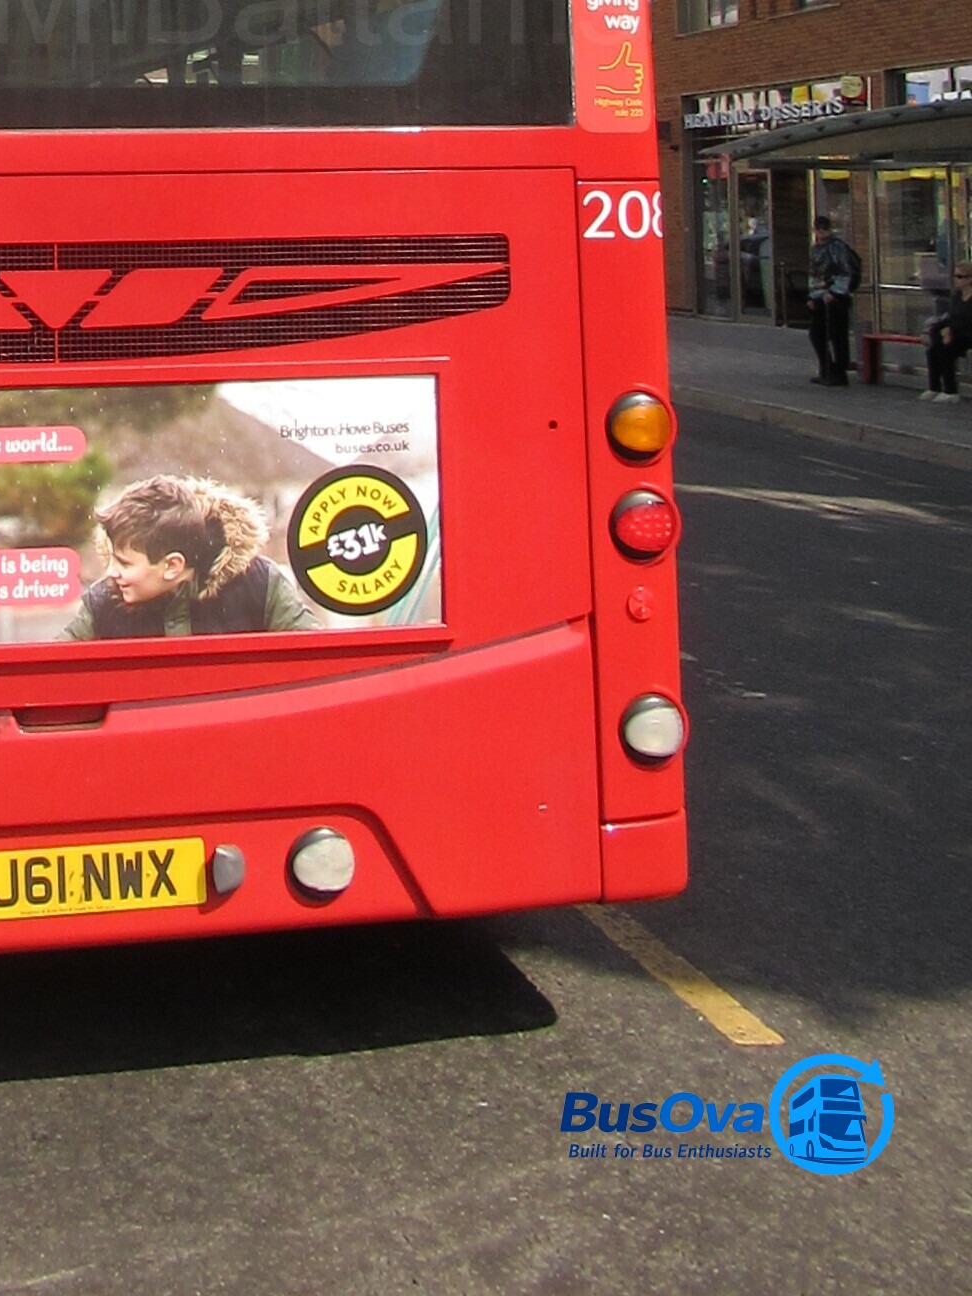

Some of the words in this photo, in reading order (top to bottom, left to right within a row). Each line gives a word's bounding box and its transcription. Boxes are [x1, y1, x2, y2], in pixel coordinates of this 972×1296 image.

[604, 14, 640, 34] way
[684, 110, 755, 130] HEAVENLY
[760, 96, 845, 121] DESSERTS
[373, 422, 409, 434] Buses
[5, 432, 74, 453] world...
[335, 440, 410, 454] buses.co.uk
[308, 488, 346, 535] APPLY
[356, 485, 396, 510] NOW
[327, 523, 387, 561] £31k
[1, 556, 17, 574] is
[20, 553, 69, 578] being
[337, 560, 404, 596] SALARY
[12, 578, 69, 598] driver
[82, 848, 178, 902] NWX
